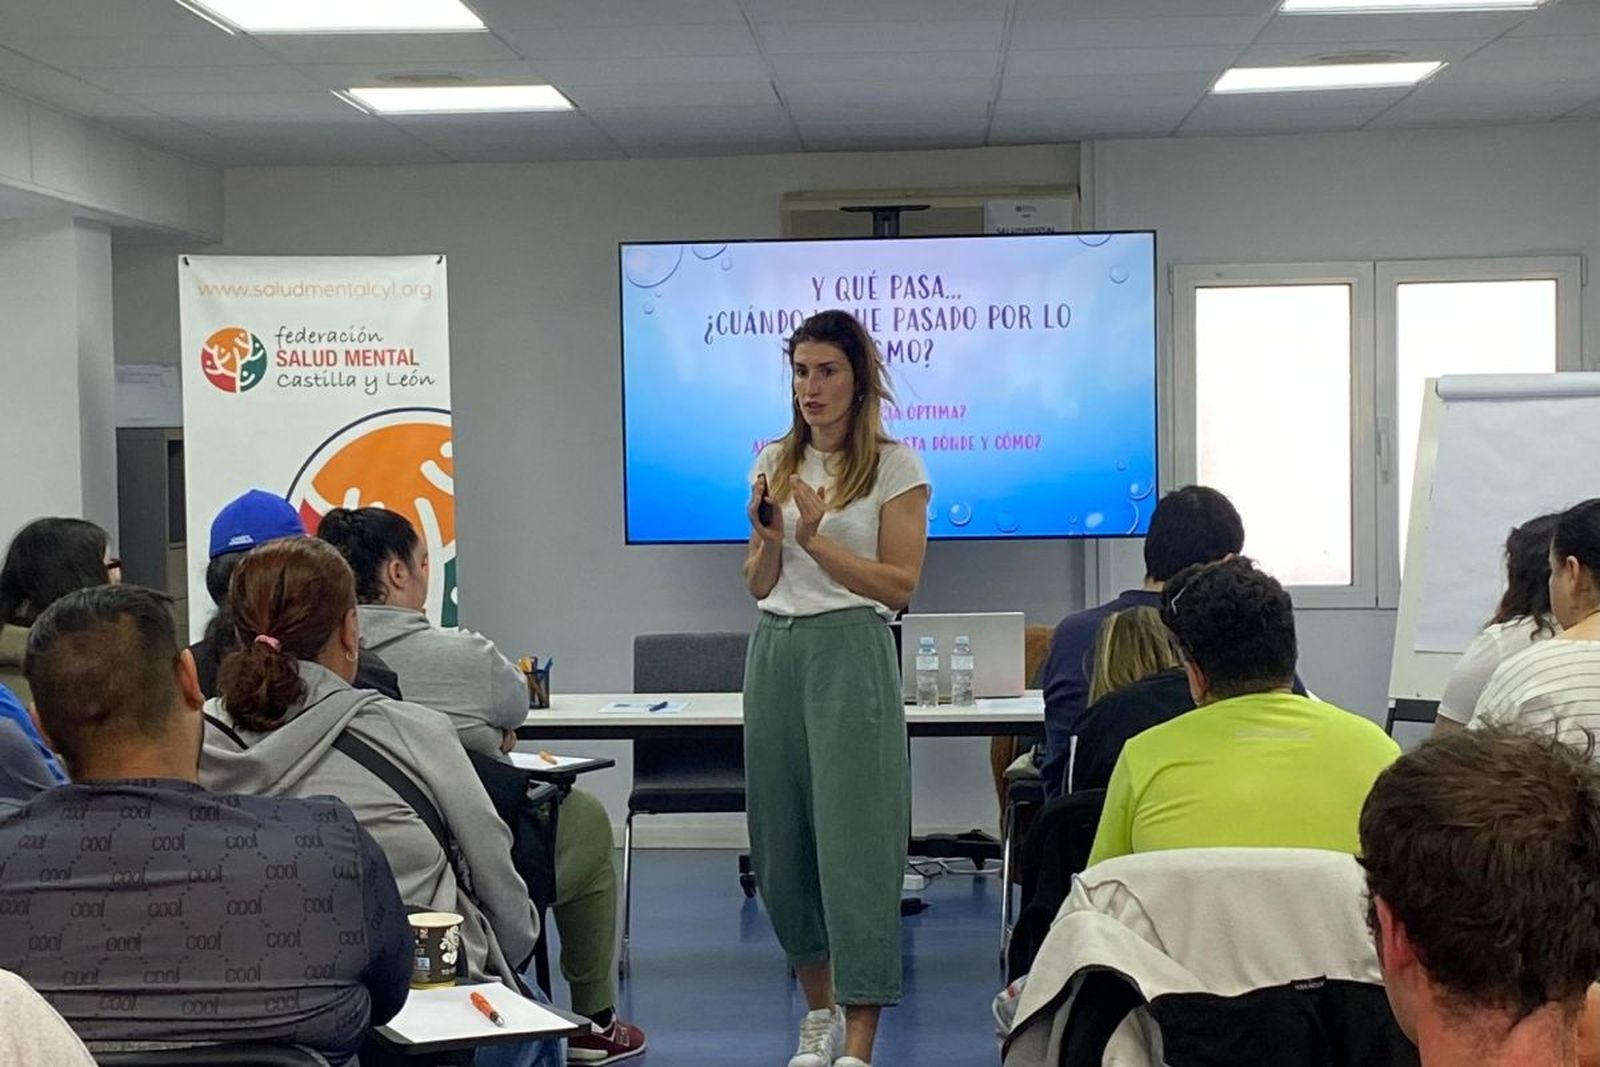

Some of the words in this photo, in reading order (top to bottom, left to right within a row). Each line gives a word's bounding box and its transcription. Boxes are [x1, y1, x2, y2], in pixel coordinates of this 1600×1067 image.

[197, 280, 432, 300] www.saludmentalcyl.org
[811, 276, 825, 301] Y
[835, 270, 879, 302] QUÉ
[890, 275, 962, 300] PASA...
[704, 307, 803, 345] ¿CUÁNDO
[855, 307, 881, 332] UE
[893, 305, 977, 332] PASADO
[988, 304, 1031, 330] POR
[1044, 303, 1072, 329] LO
[275, 325, 383, 348] federación
[276, 349, 337, 368] SALUD
[345, 348, 420, 367] MENTAL
[277, 370, 356, 388] Castilla
[365, 376, 378, 395] y
[387, 369, 435, 387] León
[907, 403, 966, 421] ÓPTIMA?
[932, 434, 975, 451] DÓNDE
[980, 435, 988, 450] Y
[995, 432, 1041, 450] CÓMO?
[120, 803, 151, 819] cool
[189, 805, 220, 821] cool
[80, 833, 112, 851] cool
[152, 833, 185, 851] cool
[225, 833, 258, 849] cool
[40, 866, 72, 882] cool
[112, 866, 146, 886] cool
[188, 864, 222, 883] cool
[265, 862, 298, 880] cool
[70, 900, 105, 918] cool
[148, 900, 183, 917] cool
[226, 896, 262, 915] cool
[303, 895, 333, 913] cool
[29, 933, 63, 950] cool
[106, 933, 142, 951] cool
[186, 932, 222, 950] cool
[266, 929, 300, 948] cool
[339, 930, 365, 946] cool
[64, 966, 99, 985] cool
[143, 966, 180, 983] cool
[225, 964, 261, 982] cool
[304, 963, 336, 980] cool
[181, 997, 219, 1016] cool
